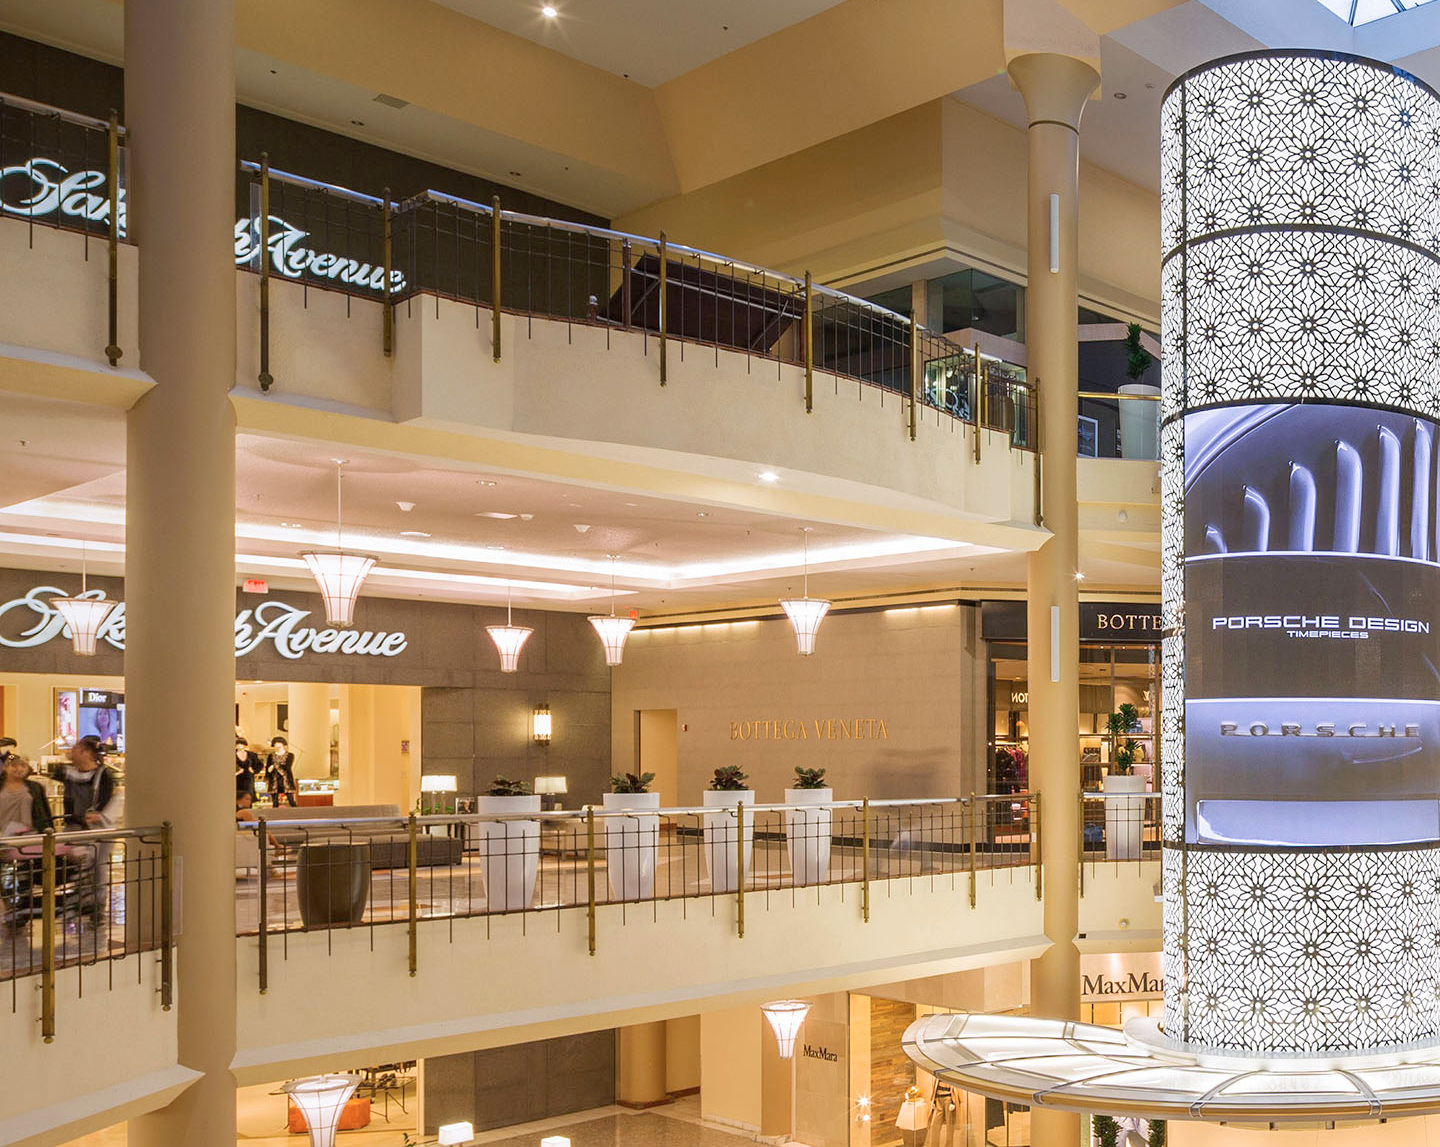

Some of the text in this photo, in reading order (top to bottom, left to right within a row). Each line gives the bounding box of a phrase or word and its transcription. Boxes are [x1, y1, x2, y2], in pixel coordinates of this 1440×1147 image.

[0, 158, 126, 237] Sak
[254, 215, 407, 293] Avenue
[255, 601, 408, 660] Avenue
[1097, 614, 1162, 631] BOTTE
[1212, 616, 1430, 634] PORSCHE DESIGN
[1286, 630, 1369, 639] TIMEPIECES
[88, 692, 107, 703] Dior
[729, 718, 889, 741] BOTTEGA VENETA
[1220, 721, 1420, 737] PORSCHE
[1081, 972, 1164, 995] MaxMar
[803, 1043, 838, 1062] MaxMara
